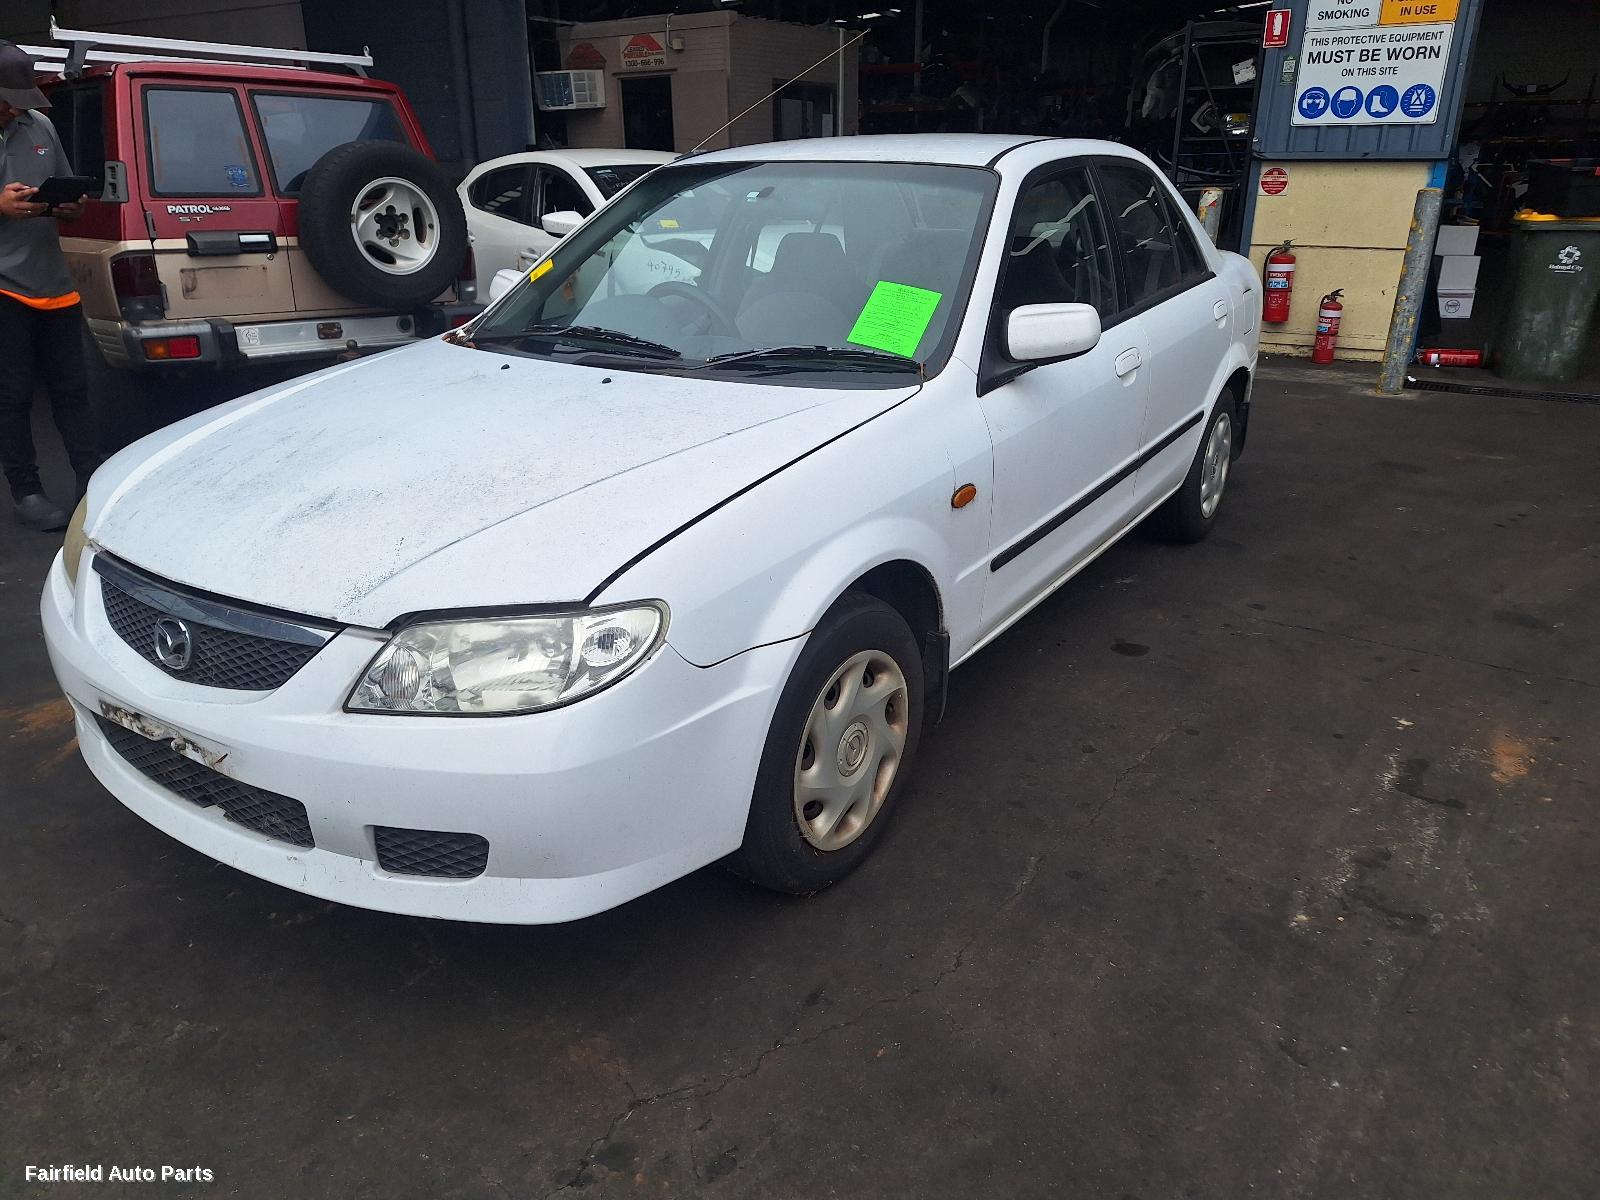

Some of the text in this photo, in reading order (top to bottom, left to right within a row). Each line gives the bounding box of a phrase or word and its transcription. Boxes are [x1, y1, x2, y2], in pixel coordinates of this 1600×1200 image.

[1317, 8, 1370, 20] SMOKING
[1400, 5, 1437, 16] IN USE
[1310, 31, 1444, 46] THIS PROTECTIVE EQUIPMENT
[1307, 45, 1441, 64] MUST BE WORN
[1341, 66, 1399, 77] ON THIS SITE
[166, 204, 213, 214] PATROL
